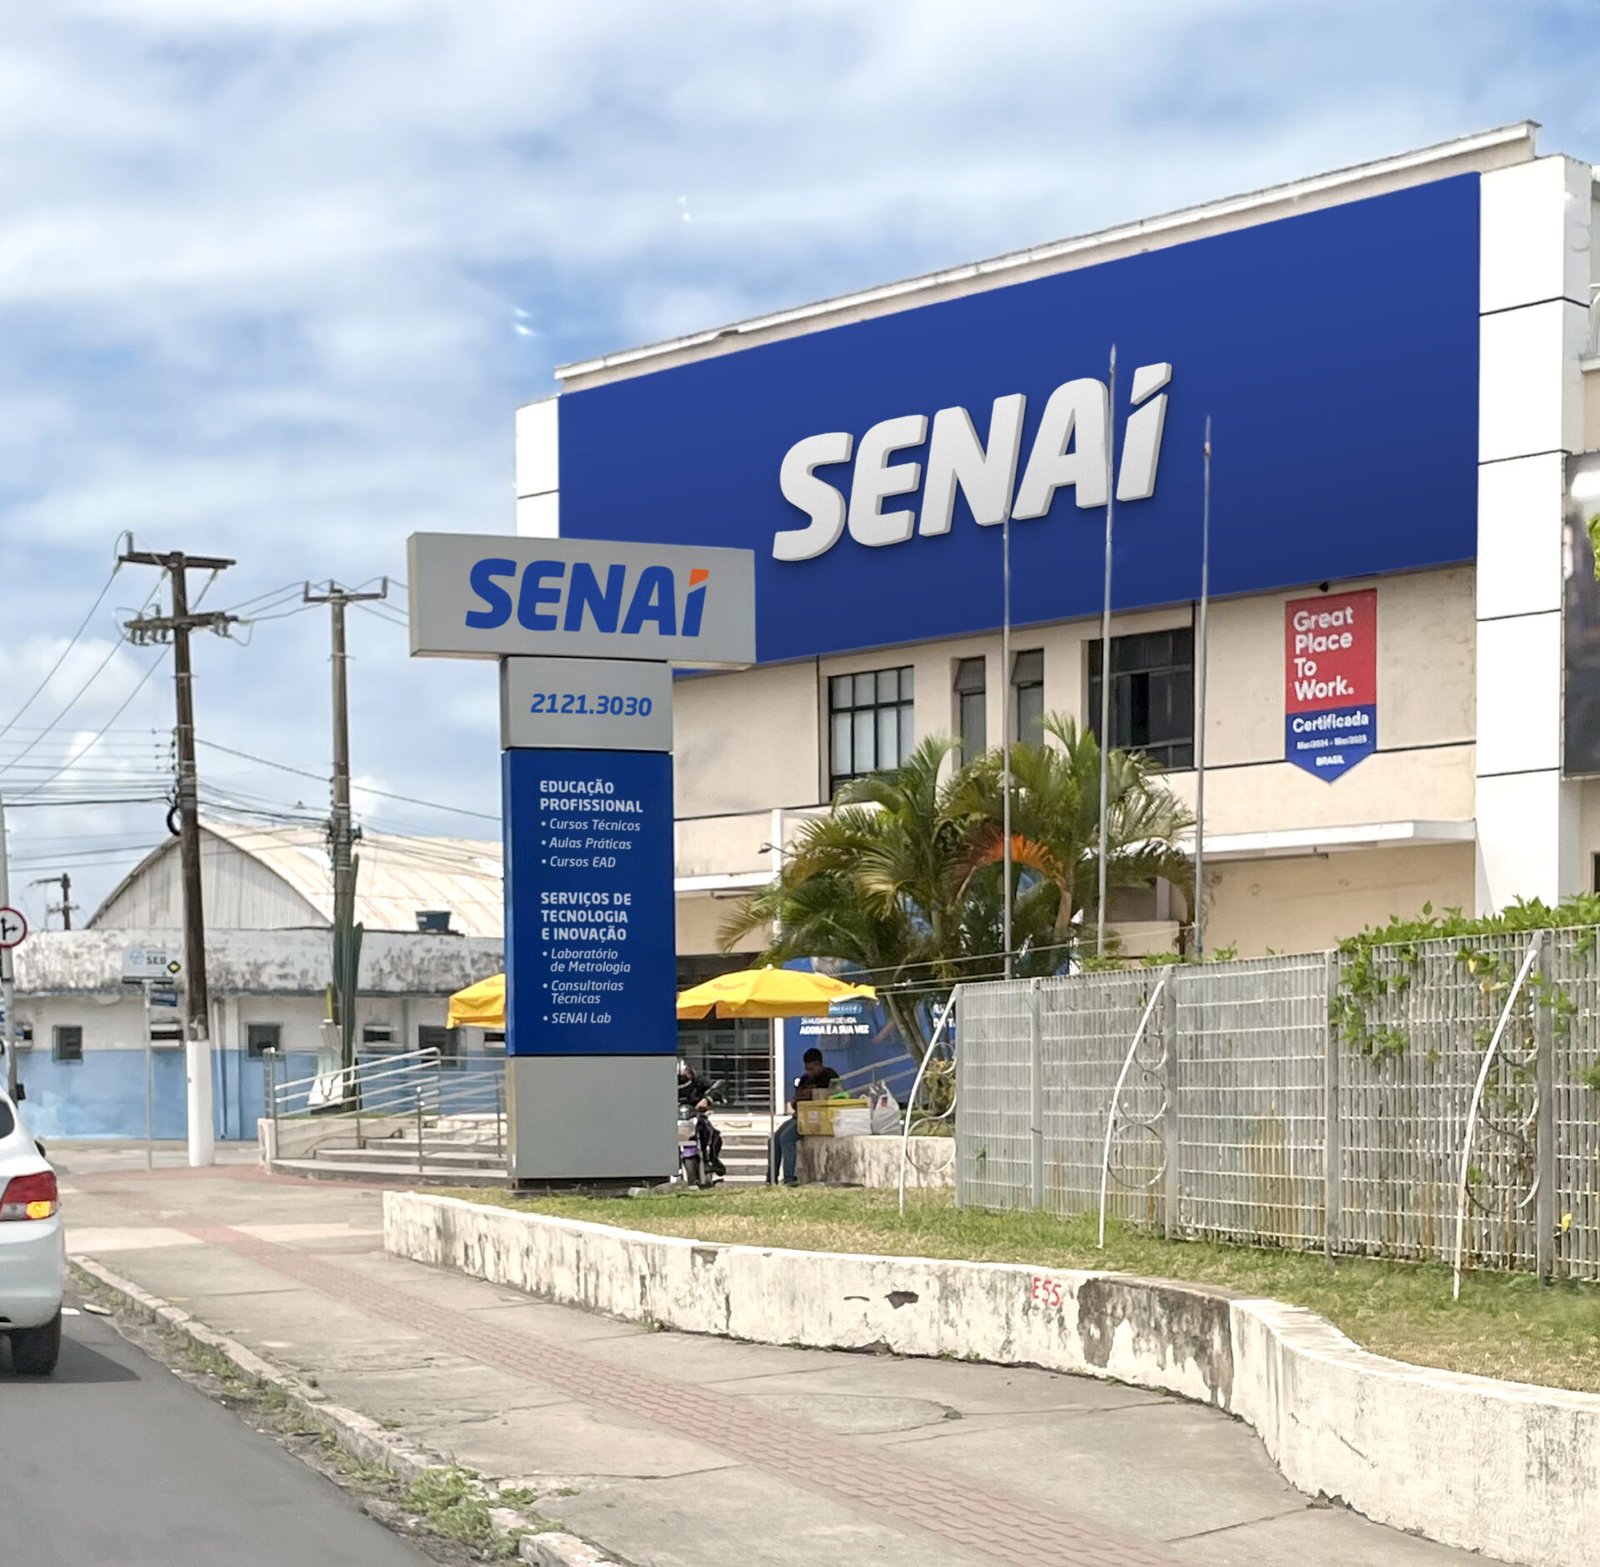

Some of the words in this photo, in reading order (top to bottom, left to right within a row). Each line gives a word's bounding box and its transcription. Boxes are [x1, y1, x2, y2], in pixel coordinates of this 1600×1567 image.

[1293, 606, 1354, 632] Great
[1295, 632, 1353, 655] Place
[1293, 657, 1317, 678] To
[1294, 675, 1354, 702] Work.
[530, 693, 653, 717] 2121.3030
[1292, 710, 1370, 734] Certificada
[1315, 754, 1346, 767] BRASIL
[539, 779, 615, 797] EDUCAÇÃO
[540, 798, 644, 813] PROFISSIONAL
[549, 818, 589, 830] Cursos
[592, 818, 641, 832] Técnicos
[549, 837, 583, 849] Aulas
[585, 838, 632, 850] Práticas
[549, 856, 590, 868] Cursos
[592, 857, 617, 868] EAD
[540, 892, 610, 908] SERVIÇOS
[613, 893, 633, 906] DE
[541, 909, 629, 924] TECNOLOGIA
[541, 928, 550, 941] E
[553, 925, 628, 944] INOVAÇÃO
[551, 948, 619, 960] Laboratório
[550, 961, 566, 973] de
[568, 961, 632, 975] Metrologia
[551, 979, 625, 992] Consultorias
[551, 992, 601, 1005] Técnicas
[551, 1012, 588, 1024] SENAI
[590, 1012, 612, 1024] Lab
[838, 1025, 854, 1034] SUA
[854, 1024, 870, 1034] VEZ
